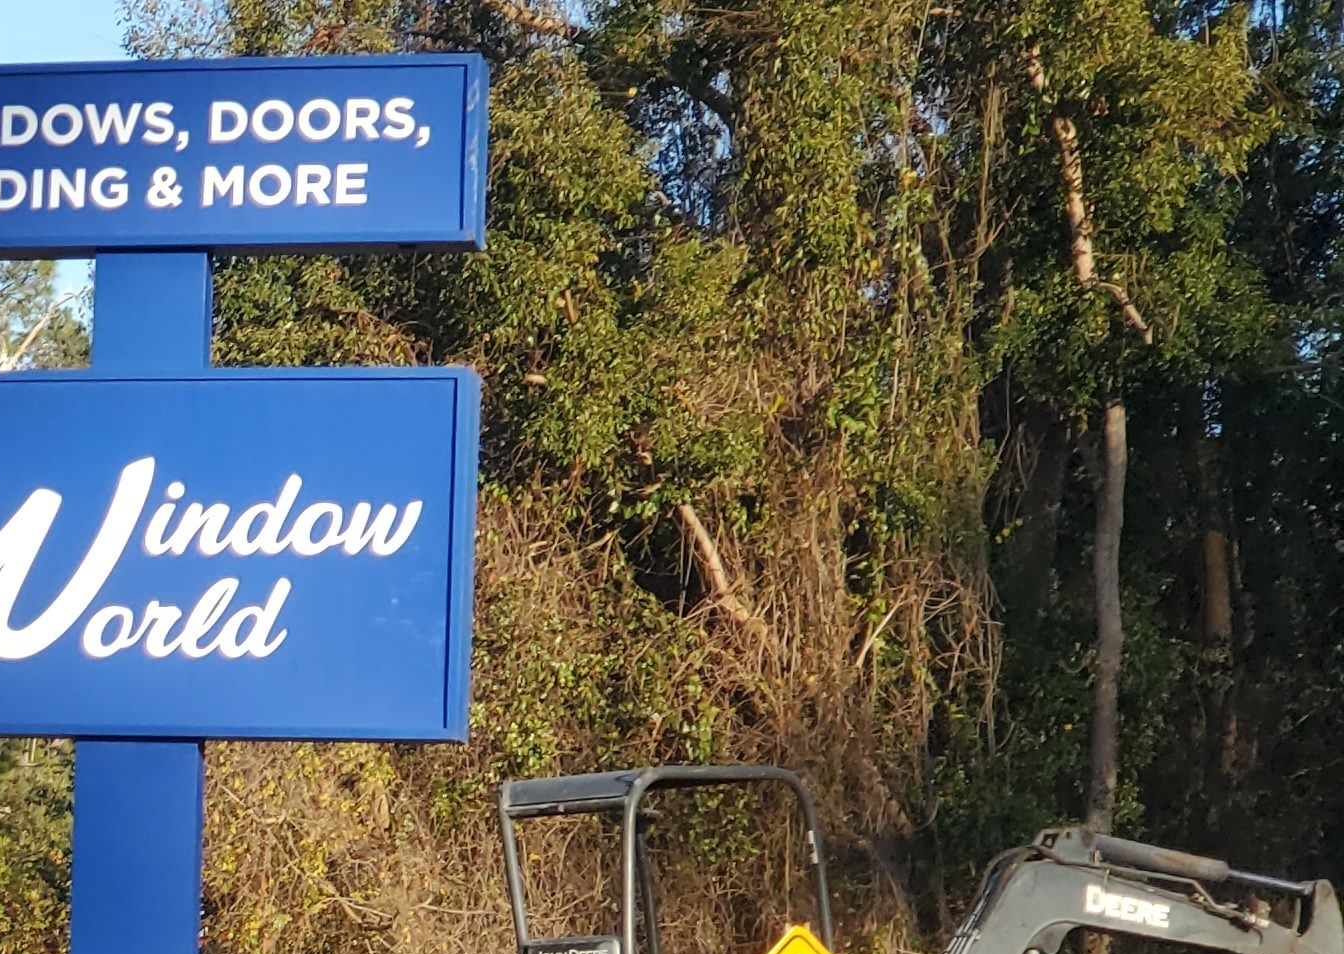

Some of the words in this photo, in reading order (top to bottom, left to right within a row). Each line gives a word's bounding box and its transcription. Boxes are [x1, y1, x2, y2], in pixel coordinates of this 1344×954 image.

[210, 97, 431, 148] DOORS,
[147, 166, 183, 208] &
[202, 163, 369, 207] MORE
[1085, 885, 1170, 928] DEERE
